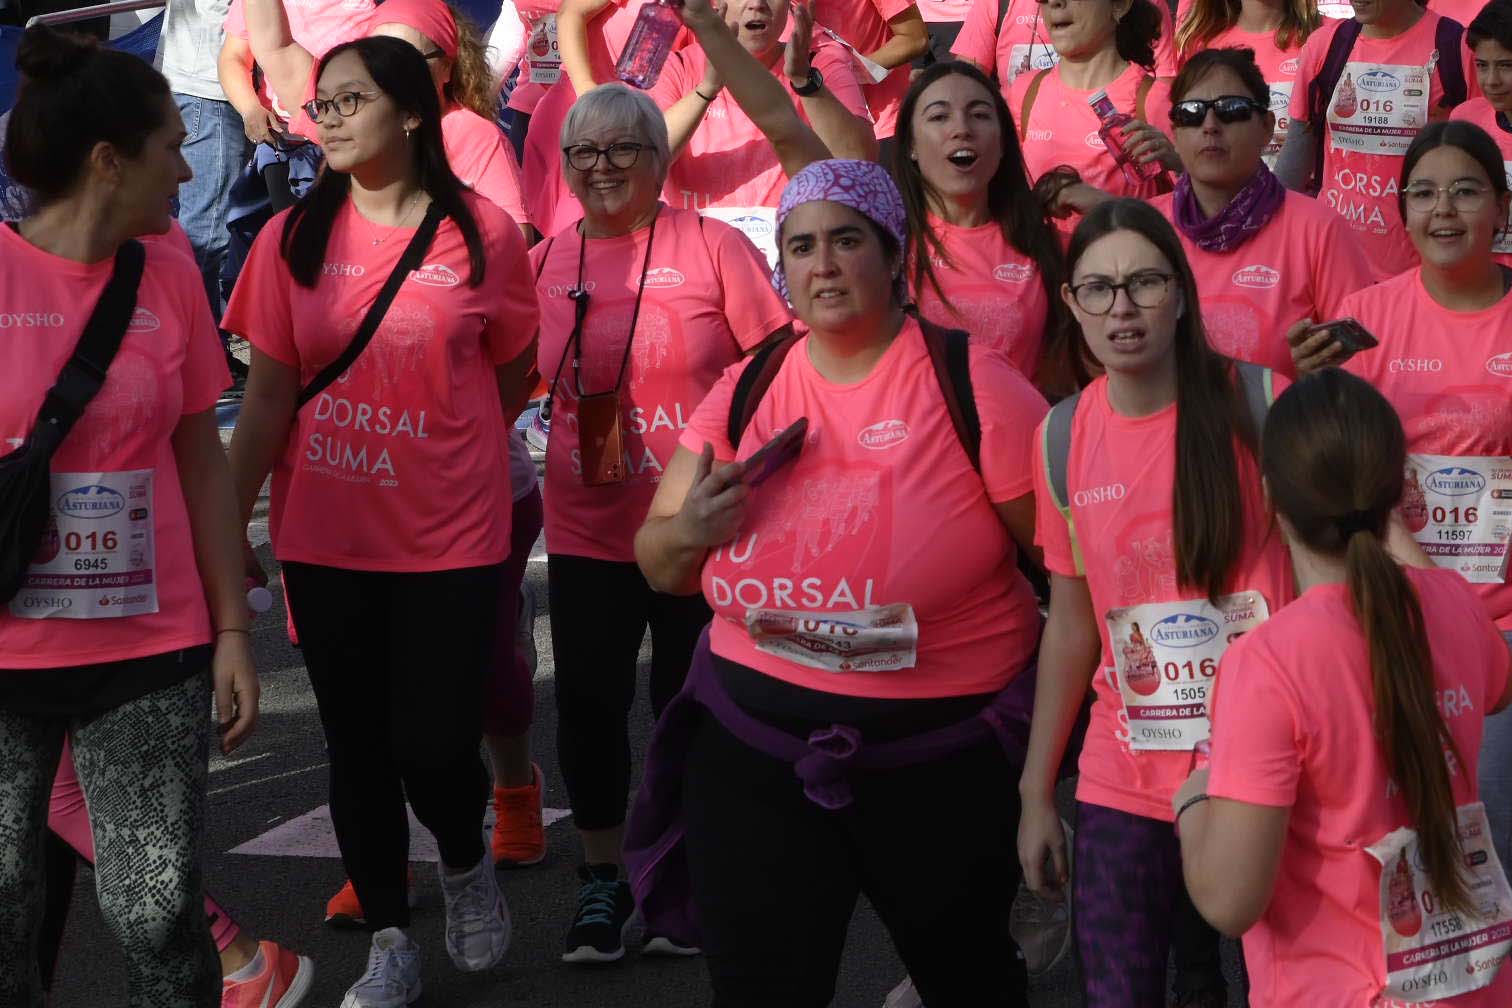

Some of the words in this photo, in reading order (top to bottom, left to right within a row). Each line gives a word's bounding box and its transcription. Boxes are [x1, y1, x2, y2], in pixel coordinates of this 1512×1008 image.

[1360, 99, 1394, 113] 016
[1362, 115, 1389, 125] 19188
[1382, 128, 1402, 136] MUJER
[322, 264, 366, 277] YSHO
[0, 312, 65, 329] OYSHO
[313, 392, 430, 440] DORSAL
[862, 429, 908, 445] ASTURIANA
[305, 432, 397, 477] SUMA
[1430, 476, 1482, 490] ASTURIANA
[1074, 483, 1127, 508] OYSHO
[62, 498, 120, 511] ASTURIANA
[1432, 506, 1479, 524] 016
[64, 530, 118, 552] 016
[1436, 529, 1473, 541] 11597
[1438, 545, 1451, 554] DE
[1451, 545, 1462, 554] LA
[1463, 545, 1492, 554] MUJER
[74, 557, 108, 571] 6945
[73, 576, 87, 586] DE
[88, 576, 100, 585] LA
[711, 576, 877, 610] DORSAL
[23, 597, 73, 609] OYSHO
[1223, 610, 1256, 625] SUMA
[1153, 625, 1215, 642] ASTURIANA
[852, 656, 904, 670] Santander
[1164, 658, 1217, 682] 016
[1140, 707, 1179, 718] CARRERA
[1179, 706, 1193, 717] DE
[1194, 706, 1207, 716] LA
[1141, 727, 1183, 740] OYSHO
[1440, 946, 1450, 956] DE
[1451, 943, 1461, 953] LA
[1461, 933, 1488, 950] MUJER
[1401, 970, 1448, 993] OYSHO
